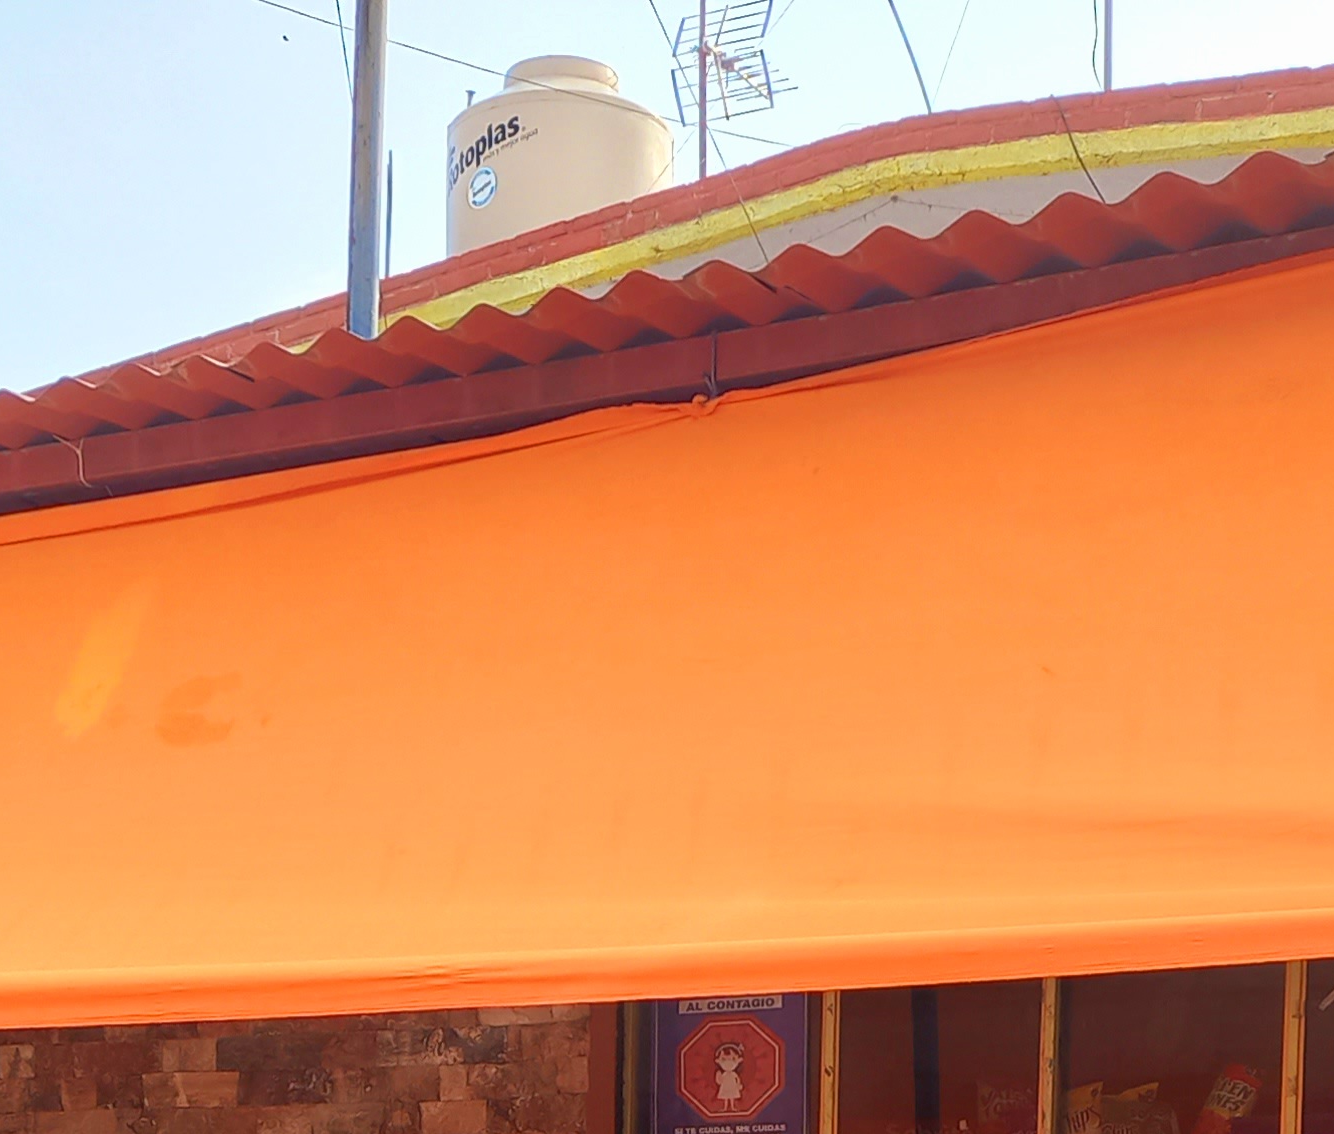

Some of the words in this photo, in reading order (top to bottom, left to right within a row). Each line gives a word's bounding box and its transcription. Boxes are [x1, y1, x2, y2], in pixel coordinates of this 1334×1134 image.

[686, 1001, 703, 1012] AL
[707, 997, 775, 1010] CONTAGIO
[699, 1125, 734, 1134] CUIDAS,
[752, 1123, 787, 1133] CUIDAS
